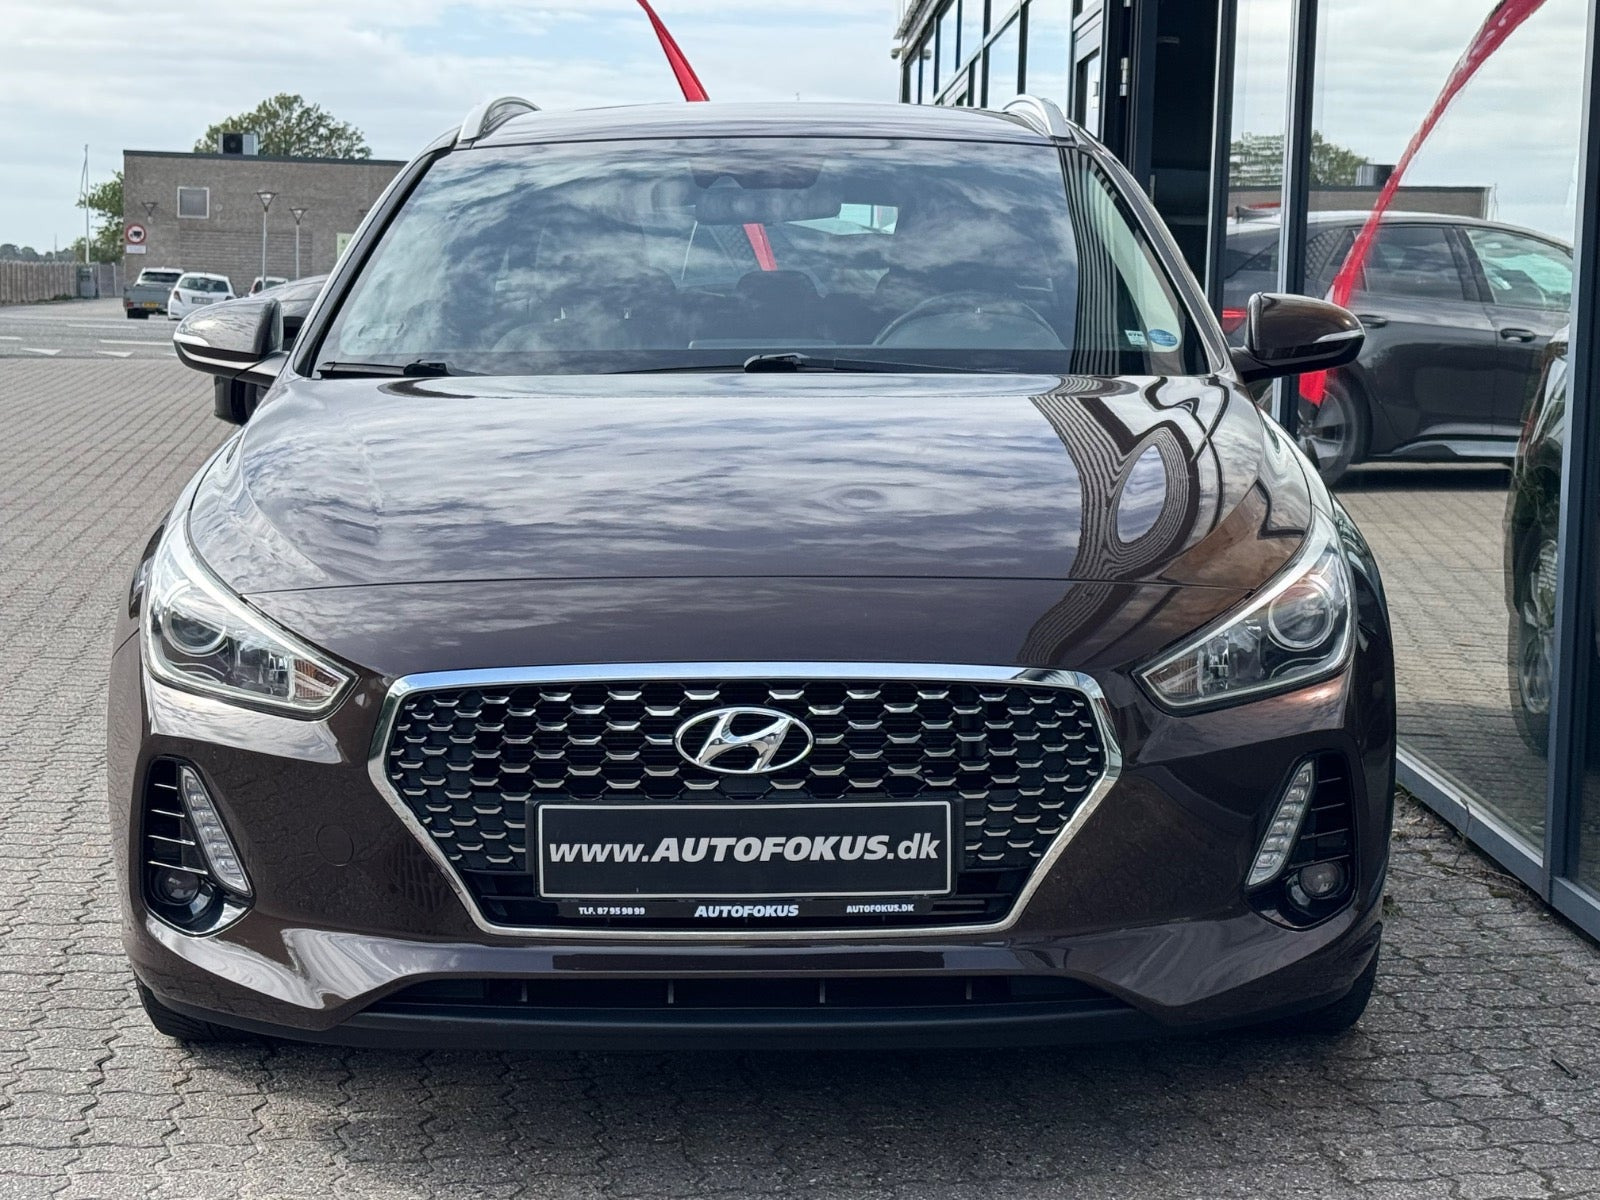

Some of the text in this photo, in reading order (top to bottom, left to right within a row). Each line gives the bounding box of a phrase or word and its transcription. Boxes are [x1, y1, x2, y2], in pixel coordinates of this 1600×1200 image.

[549, 832, 940, 863] www.AUTOFOKUS.dk
[578, 906, 596, 915] TLF.
[597, 906, 609, 915] 87
[609, 906, 621, 915] 95
[634, 906, 646, 915] 99
[694, 904, 799, 918] AUTOFOKUS
[846, 904, 915, 914] AUTOFOKUS.DK
